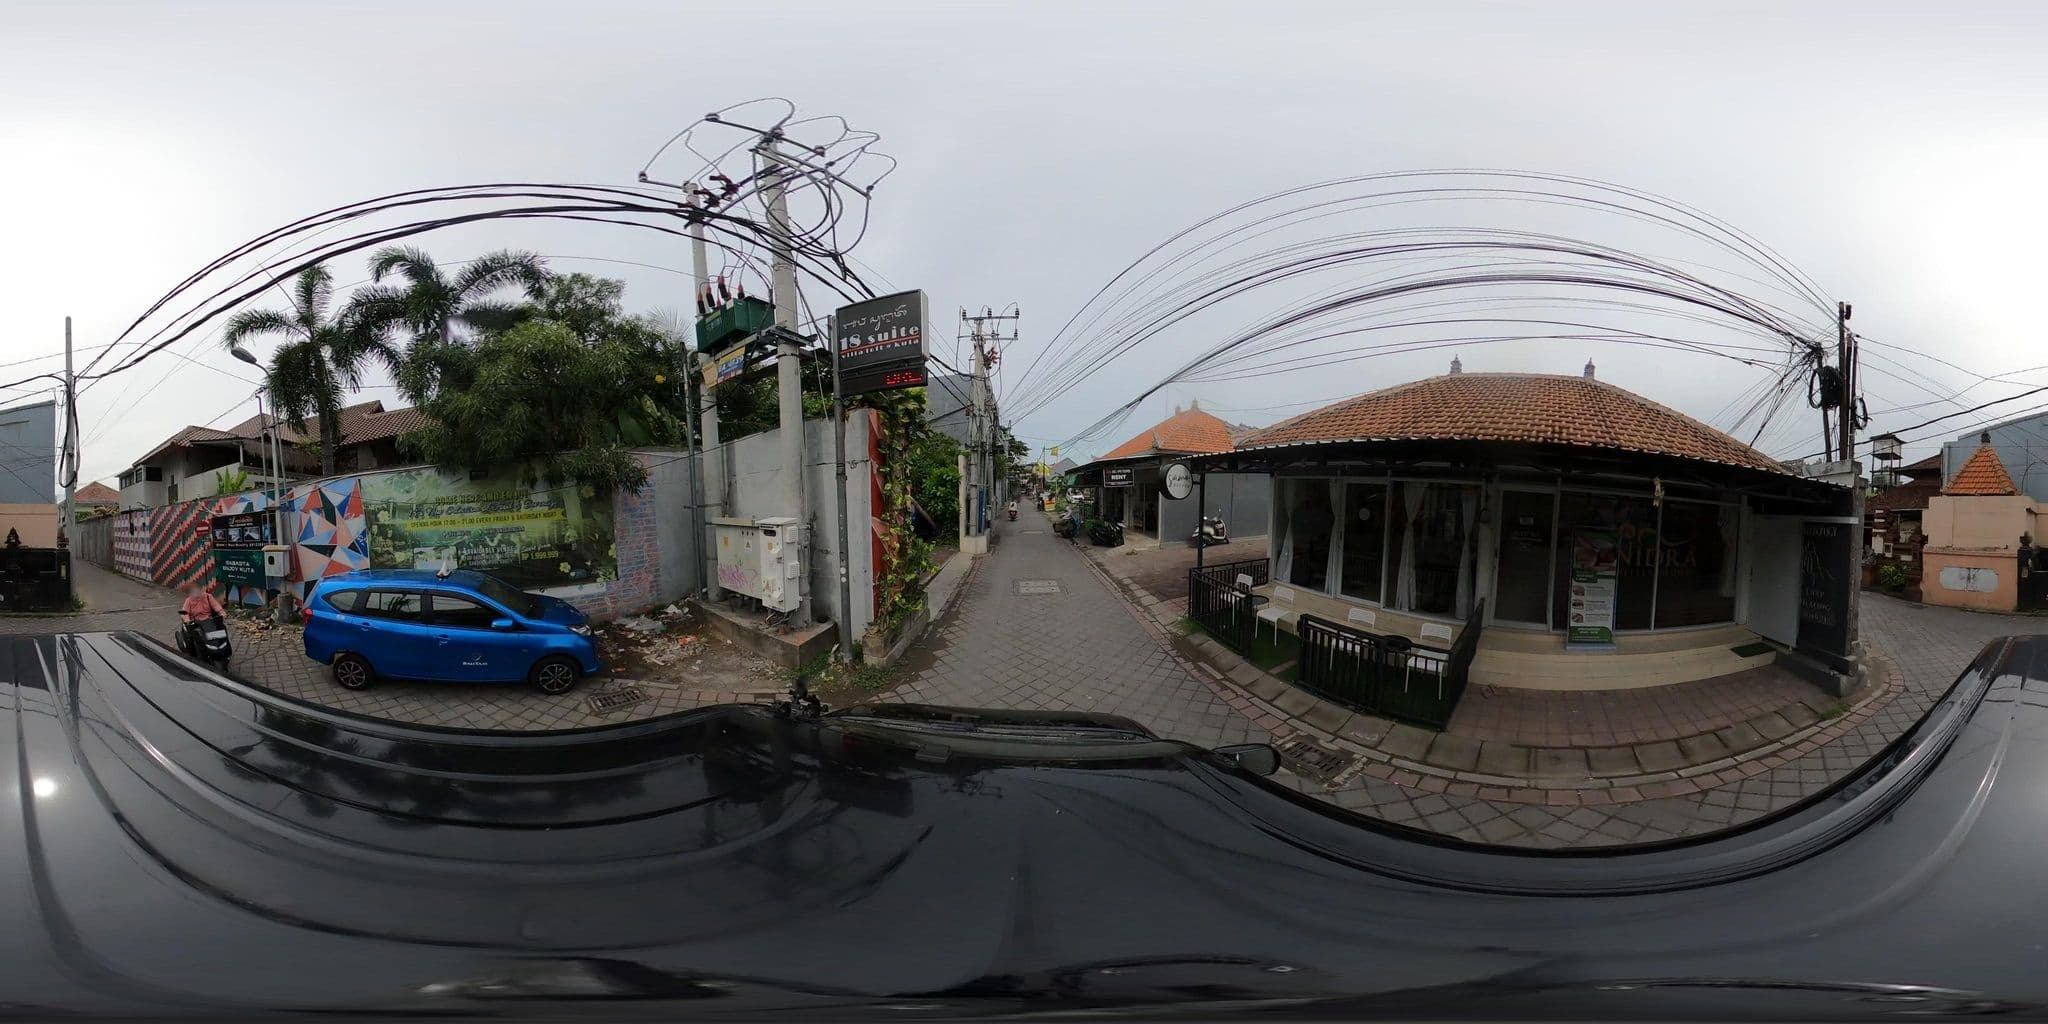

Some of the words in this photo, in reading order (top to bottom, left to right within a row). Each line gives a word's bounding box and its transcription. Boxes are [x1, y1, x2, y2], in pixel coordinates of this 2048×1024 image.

[839, 334, 862, 351] 18
[867, 325, 919, 344] suite
[475, 516, 492, 524] EVERY
[493, 515, 510, 523] FRIDAY
